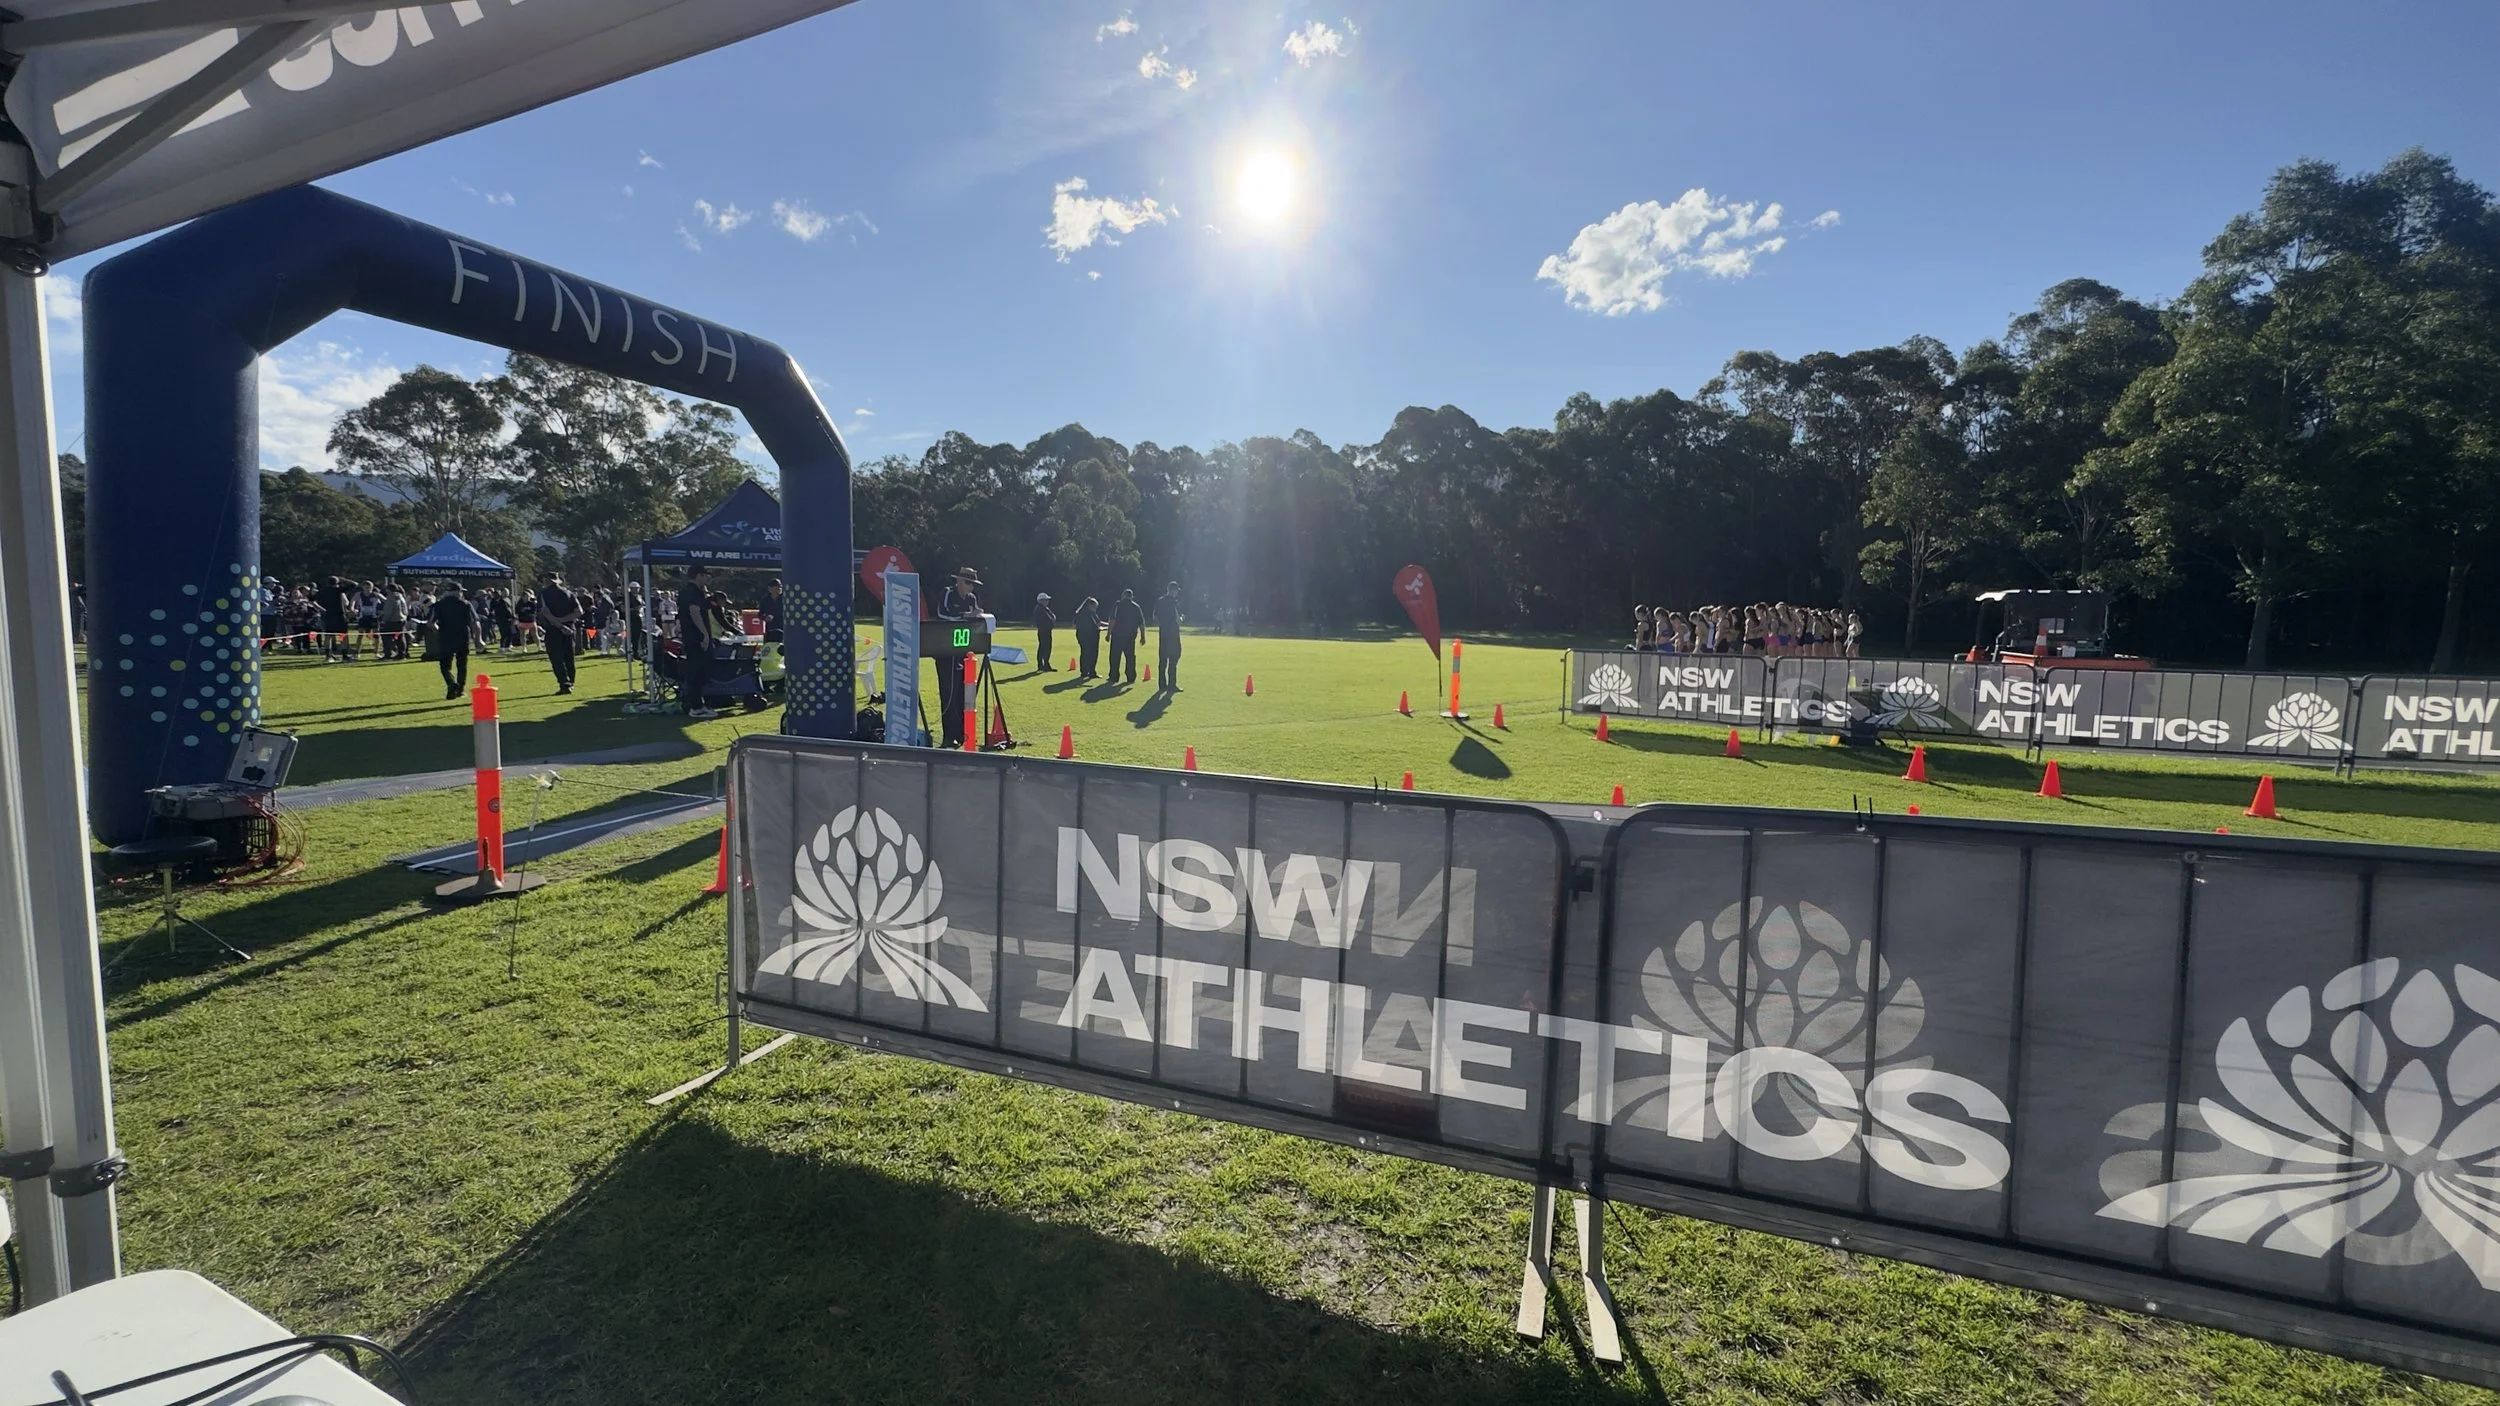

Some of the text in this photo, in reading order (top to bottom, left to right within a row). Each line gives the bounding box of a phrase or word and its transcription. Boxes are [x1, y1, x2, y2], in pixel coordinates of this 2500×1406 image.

[448, 238, 738, 383] FINISH
[715, 551, 740, 559] ARE
[892, 583, 911, 637] NSW
[1659, 666, 1734, 689] NSW
[1978, 680, 2081, 707] NSW
[1659, 692, 1852, 722] ATHLETICS
[2383, 695, 2500, 723] NSW
[1977, 709, 2229, 744] ATHLETICS
[1055, 826, 1374, 947] NSW
[1056, 946, 2011, 1191] ATHLETICS
